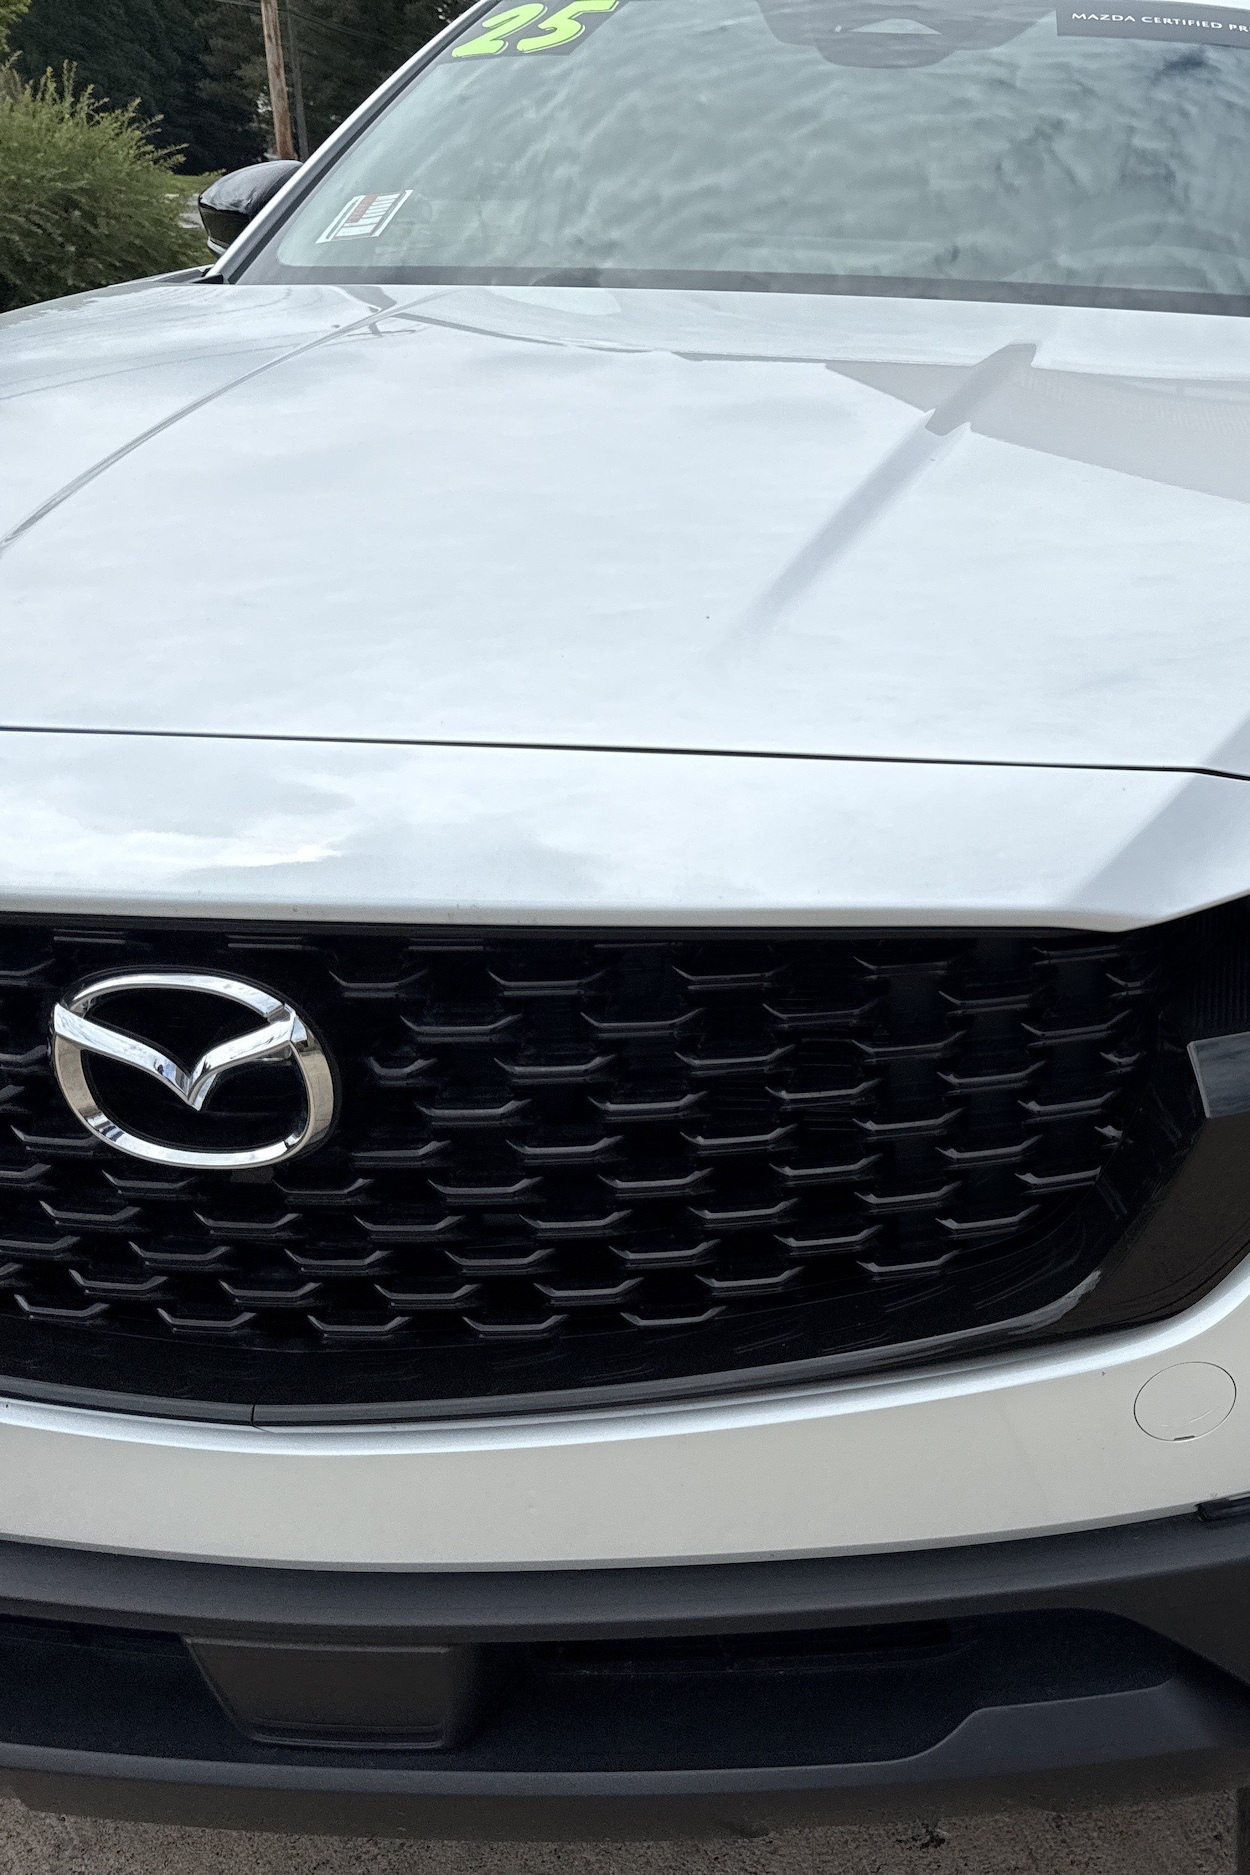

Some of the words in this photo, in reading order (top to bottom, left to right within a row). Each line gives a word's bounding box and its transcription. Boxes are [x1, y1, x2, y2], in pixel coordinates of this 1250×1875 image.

[452, 0, 619, 57] 25
[1071, 13, 1136, 22] MAZDA
[1141, 16, 1223, 29] CERTIFIED
